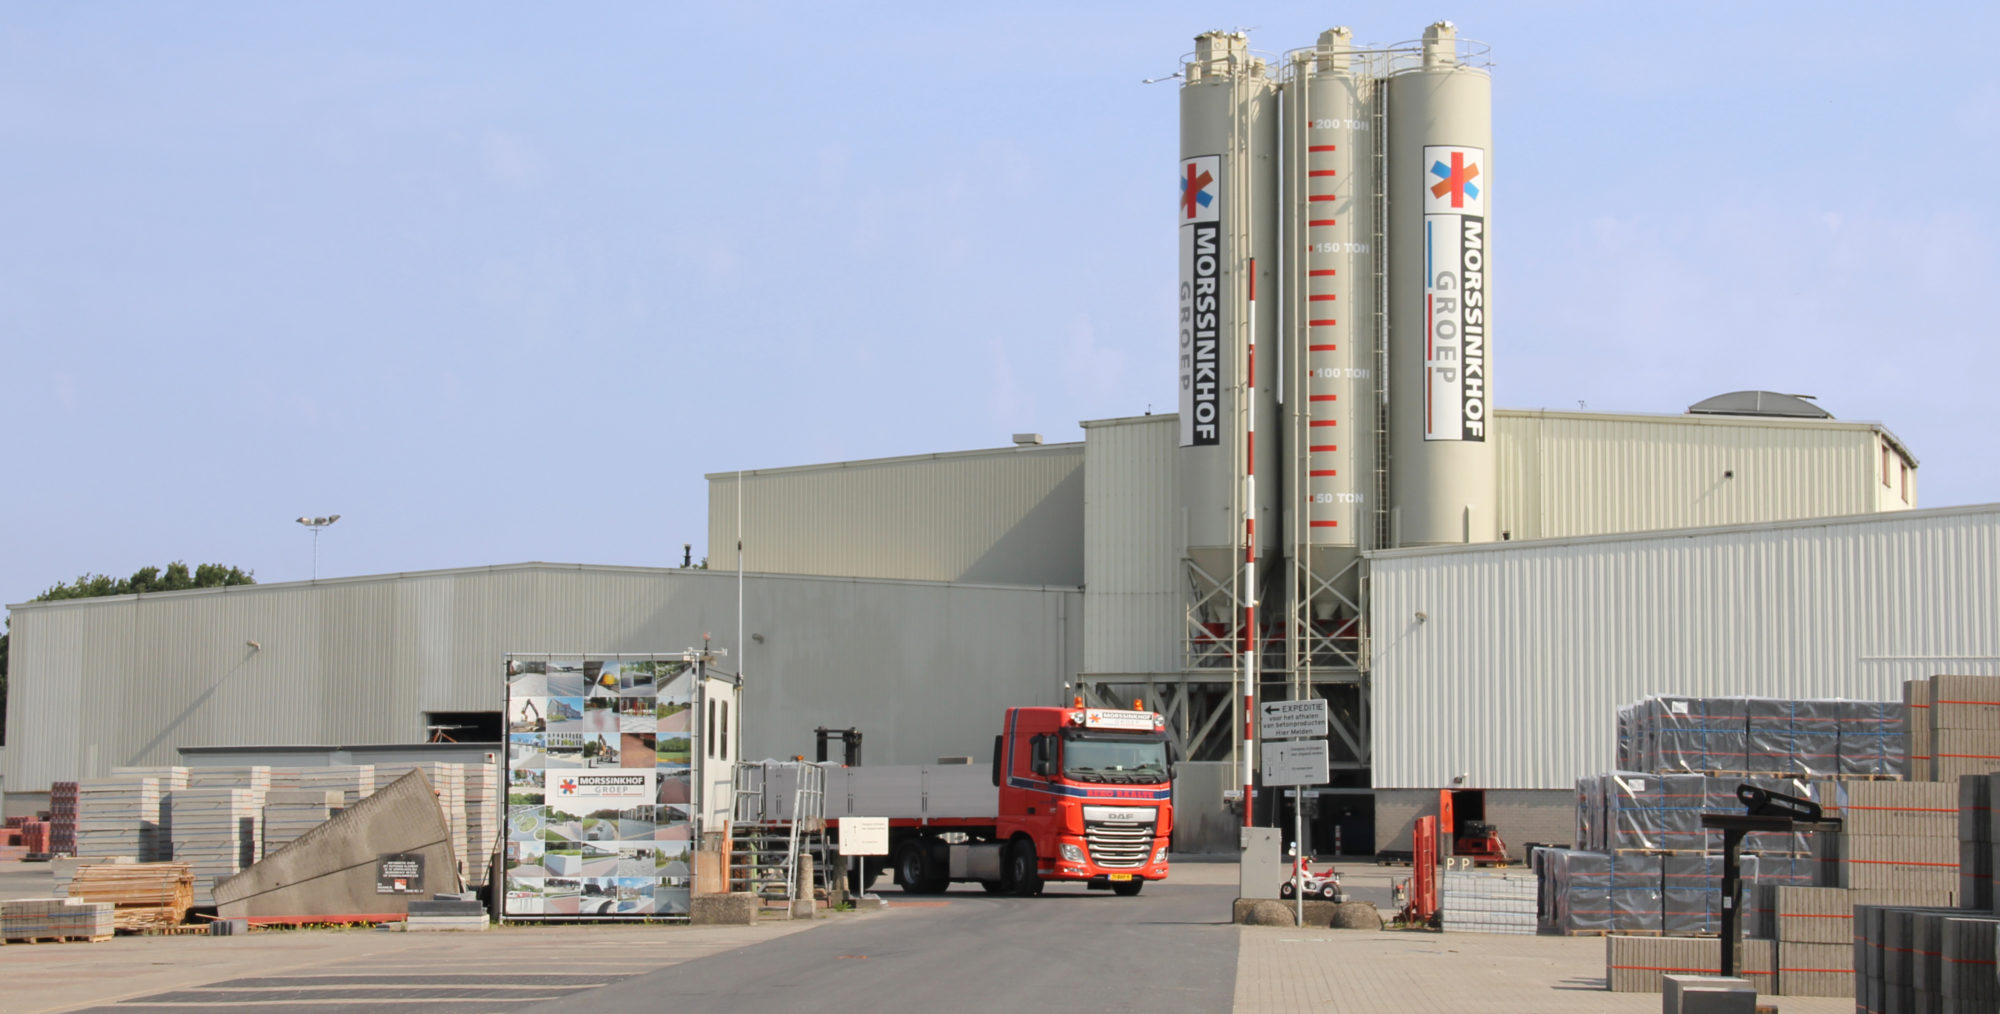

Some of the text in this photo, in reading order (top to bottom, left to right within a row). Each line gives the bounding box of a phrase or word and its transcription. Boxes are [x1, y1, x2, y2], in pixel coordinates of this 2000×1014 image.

[1315, 119, 1369, 131] 200 TON
[1316, 243, 1370, 254] 150 TON
[1196, 227, 1216, 439] MORSSINKHOF
[1436, 271, 1457, 383] GROEP
[1464, 220, 1483, 437] MORSSINKHOF
[1180, 281, 1191, 390] GROEP
[1316, 368, 1370, 380] 100 TON
[1316, 493, 1364, 503] 50 TON
[1282, 703, 1323, 713] EXPEDITIE
[1275, 720, 1325, 728] betonproducten
[580, 777, 643, 785] MORSSINKHOF
[1447, 858, 1470, 870] P P
